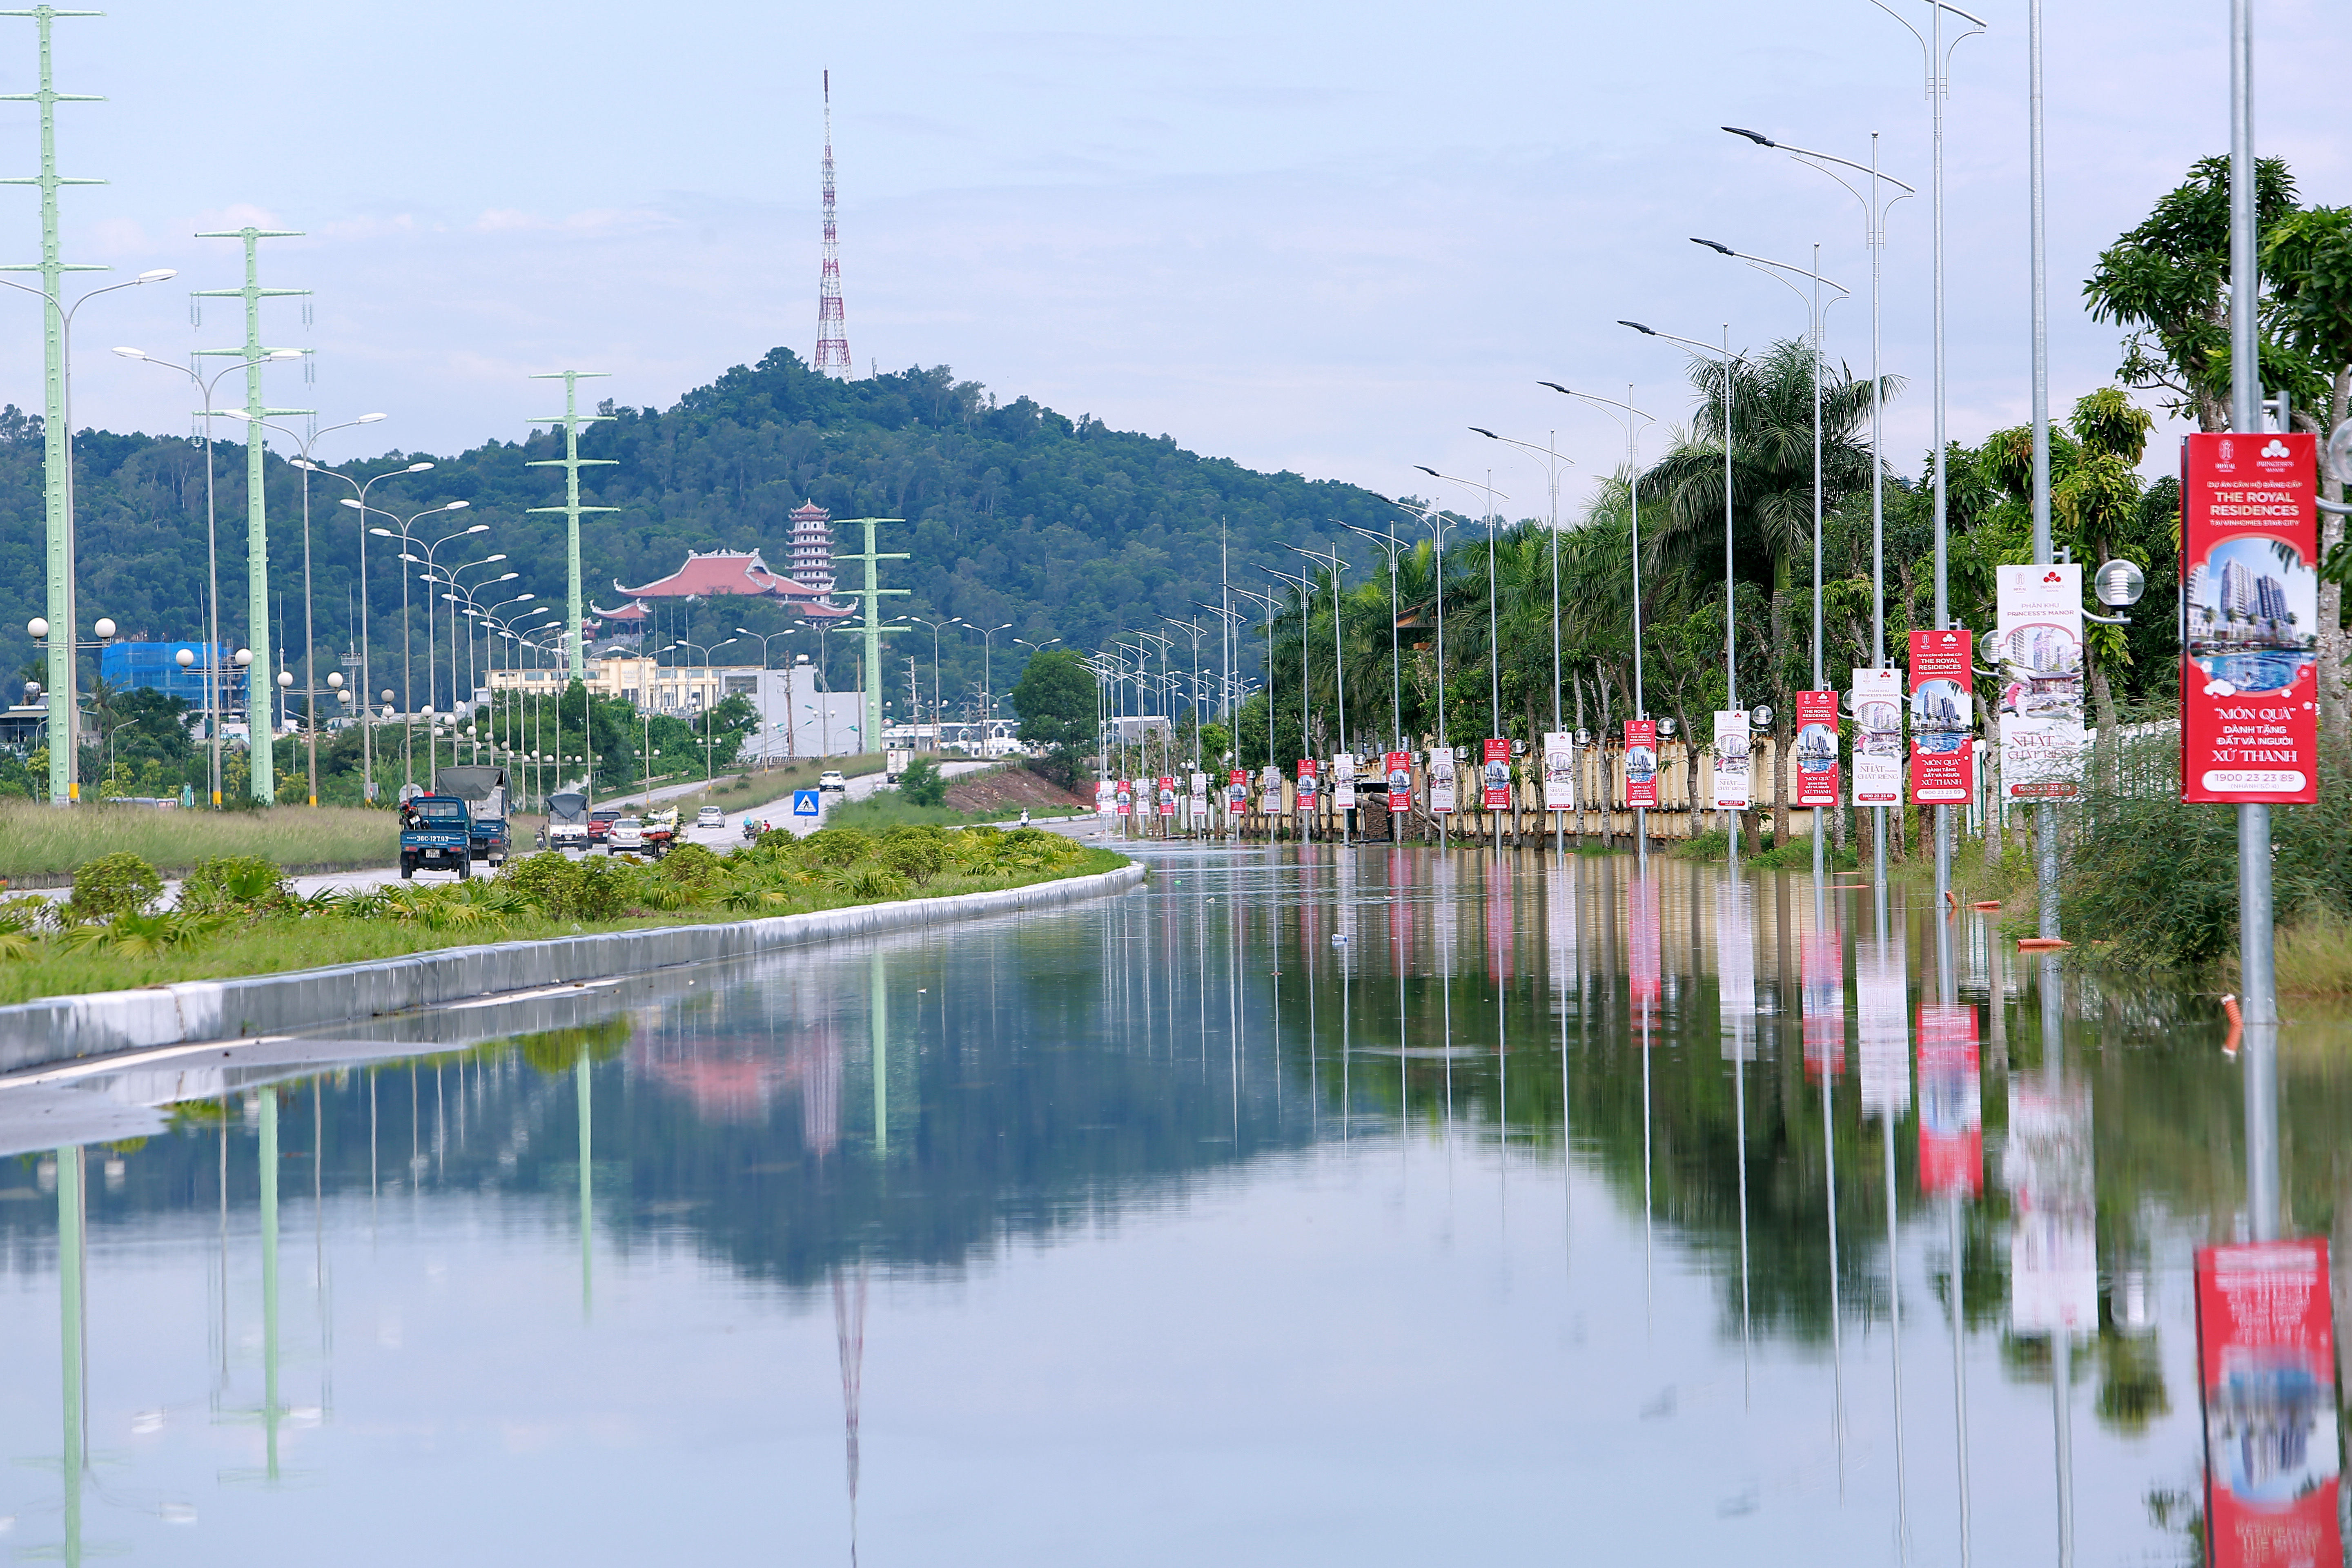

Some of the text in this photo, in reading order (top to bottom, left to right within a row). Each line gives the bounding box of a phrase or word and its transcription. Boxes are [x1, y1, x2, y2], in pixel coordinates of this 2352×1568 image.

[2214, 492, 2295, 503] THE ROYAL
[2210, 505, 2299, 516] RESIDENCES
[2223, 724, 2286, 735] DÀNH TẶNG
[2216, 735, 2293, 745] ĐẤT VÀ NGƯỜI
[2212, 748, 2298, 762] XỨ THANH
[1860, 765, 1885, 773] NHẬT
